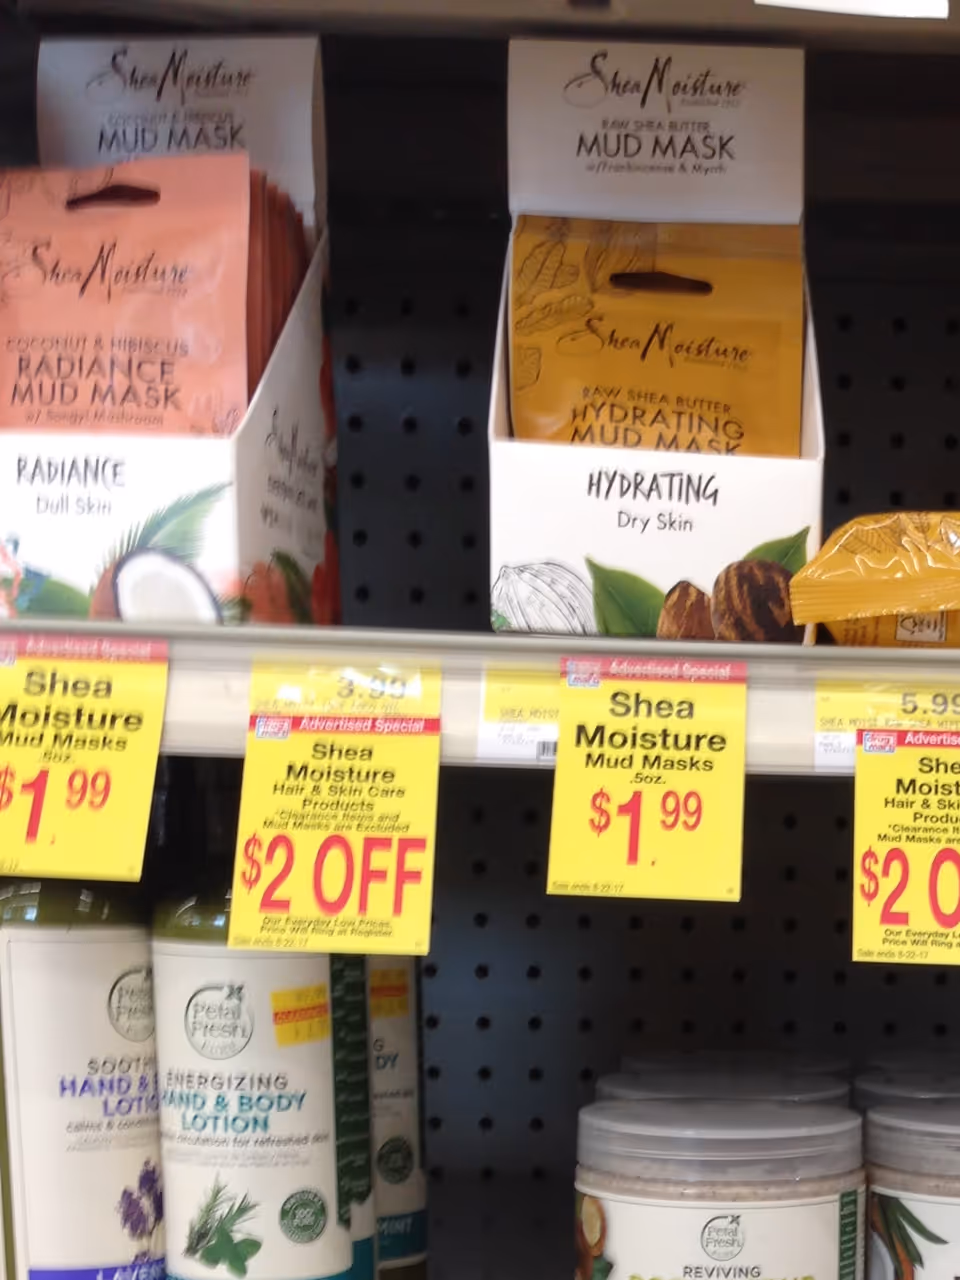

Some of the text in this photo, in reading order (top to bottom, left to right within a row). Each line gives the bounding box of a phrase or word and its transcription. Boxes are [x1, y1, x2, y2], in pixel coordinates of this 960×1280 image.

[98, 124, 247, 153] MUD MASK
[576, 133, 736, 160] MUD MASK
[17, 354, 176, 384] RADIANCE
[11, 383, 181, 410] MUD MASK
[570, 400, 745, 441] HYDRATING
[16, 457, 126, 487] RADIANCE
[587, 469, 719, 506] HYDRATING
[617, 510, 694, 534] Dry Skin
[24, 670, 113, 699] Shea
[609, 691, 694, 718] Shea
[311, 742, 373, 761] Shea
[575, 724, 727, 752] Moisture
[286, 764, 395, 784] Moisture
[585, 753, 714, 771] Mud Masks
[884, 798, 916, 810] Hair
[920, 799, 931, 811] &
[241, 832, 427, 917] $2 OFF
[860, 846, 910, 926] $2
[905, 929, 950, 941] Everyday
[238, 1092, 306, 1113] BODY
[182, 1112, 270, 1134] LOTION
[683, 1265, 761, 1278] REVIVING
